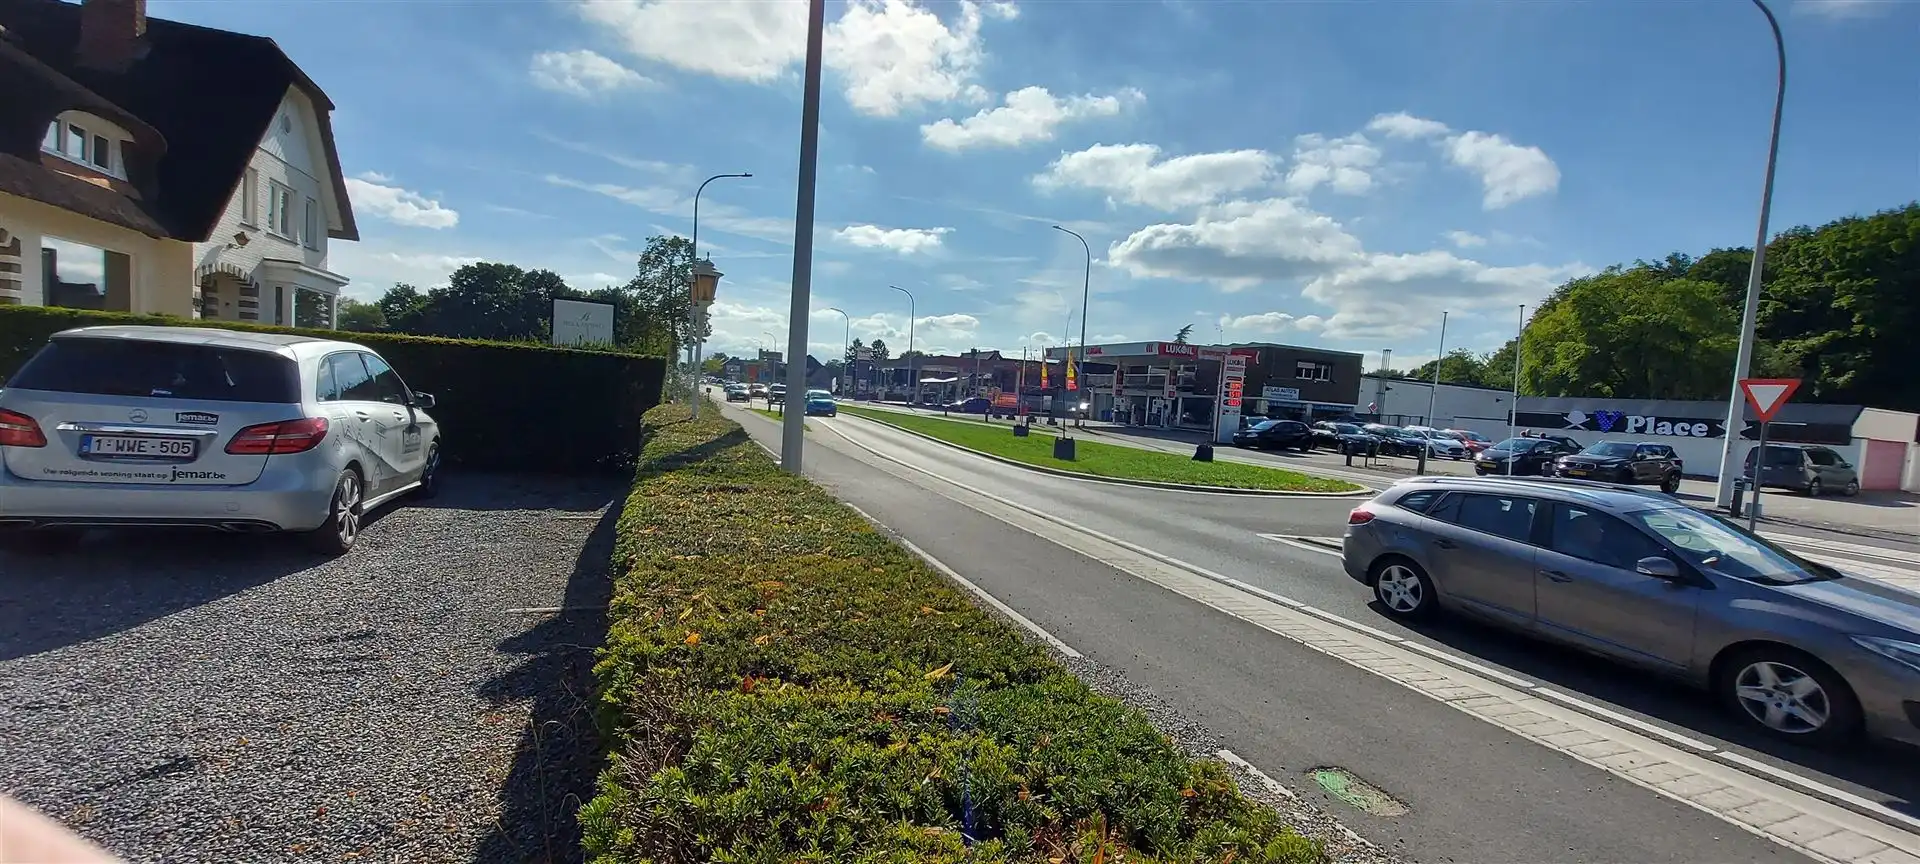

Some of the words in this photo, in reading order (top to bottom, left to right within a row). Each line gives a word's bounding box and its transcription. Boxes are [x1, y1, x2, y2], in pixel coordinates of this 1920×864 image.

[1165, 344, 1194, 355] LUKOIL
[1625, 415, 1709, 437] Place
[170, 465, 227, 483] jemar.be
